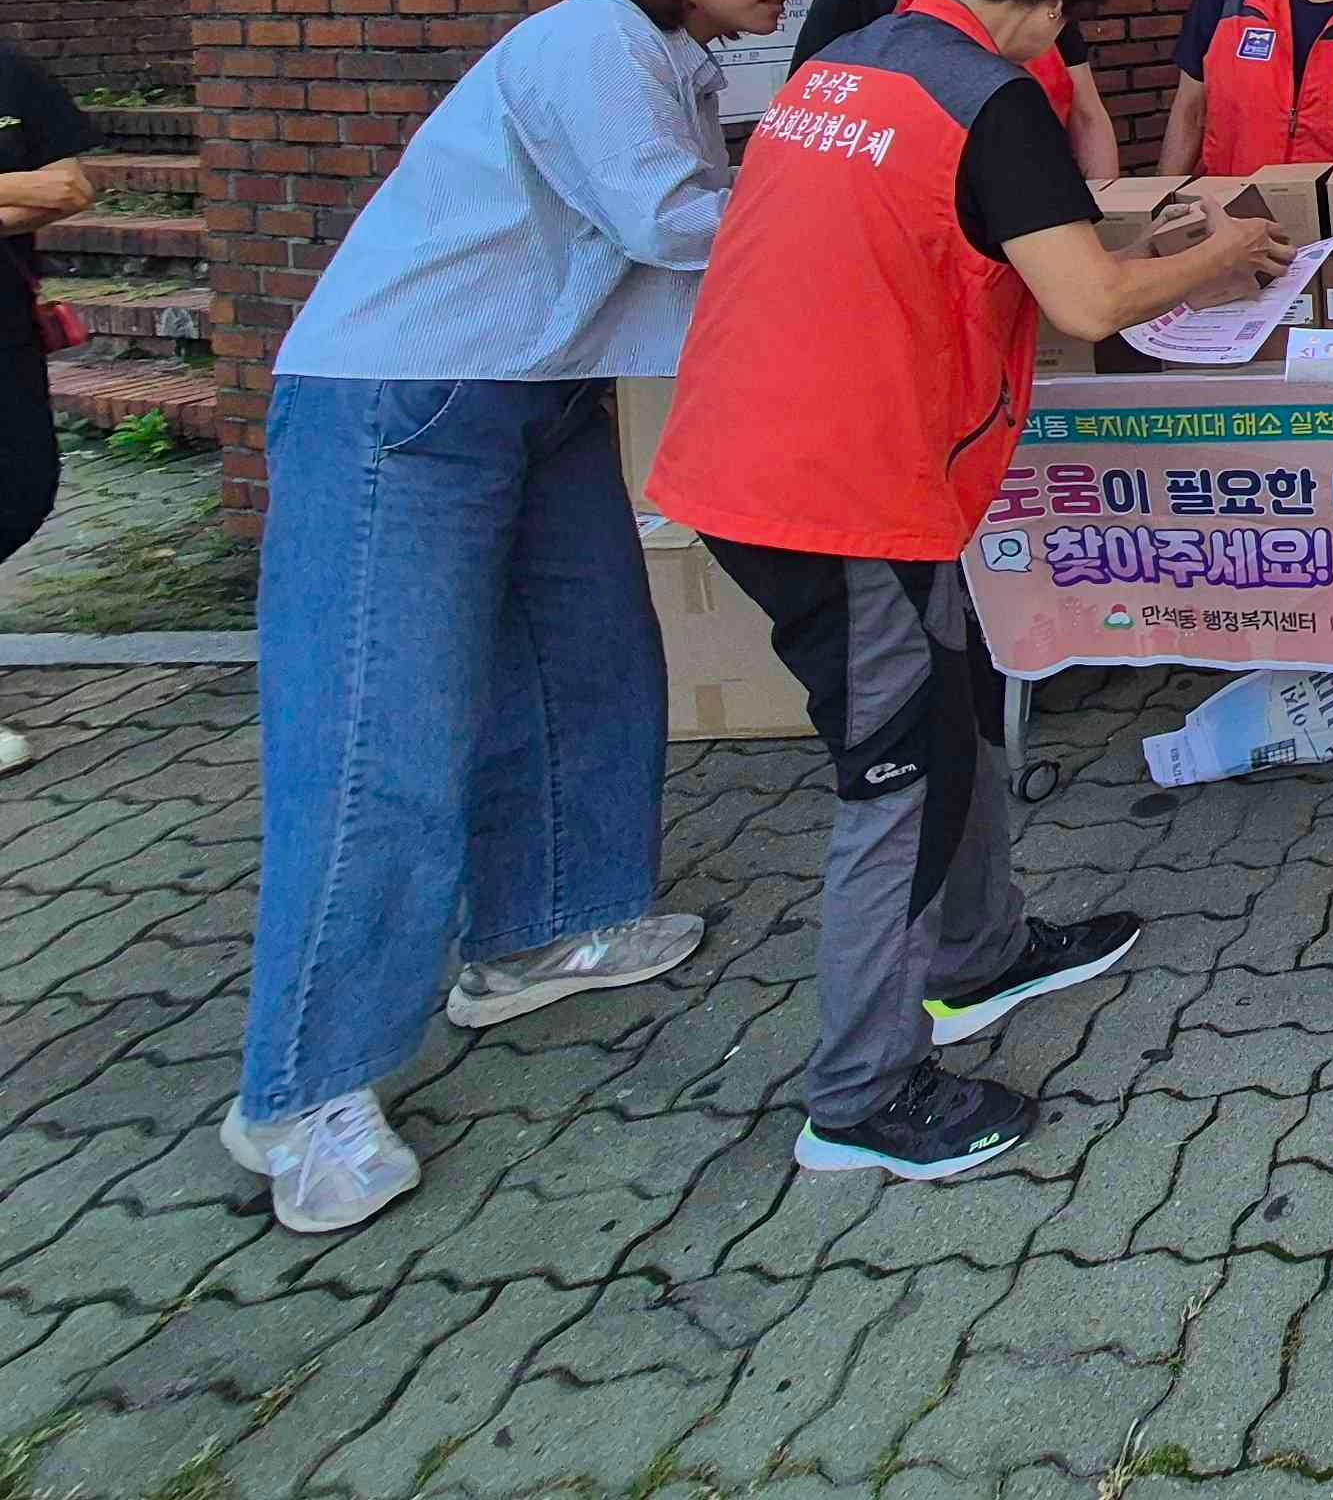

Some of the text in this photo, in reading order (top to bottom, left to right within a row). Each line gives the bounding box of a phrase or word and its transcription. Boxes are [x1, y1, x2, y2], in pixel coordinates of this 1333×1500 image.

[802, 70, 863, 105] 만석동
[1075, 412, 1226, 439] 복지사각지대
[1231, 411, 1282, 437] 해소
[988, 462, 1152, 523] 도움이
[1163, 466, 1321, 518] 필요한
[1044, 524, 1333, 589] 찾아주세요!
[1142, 604, 1197, 630] 만석동
[1202, 609, 1317, 634] 행정복지센터
[968, 1132, 1000, 1154] FILA
